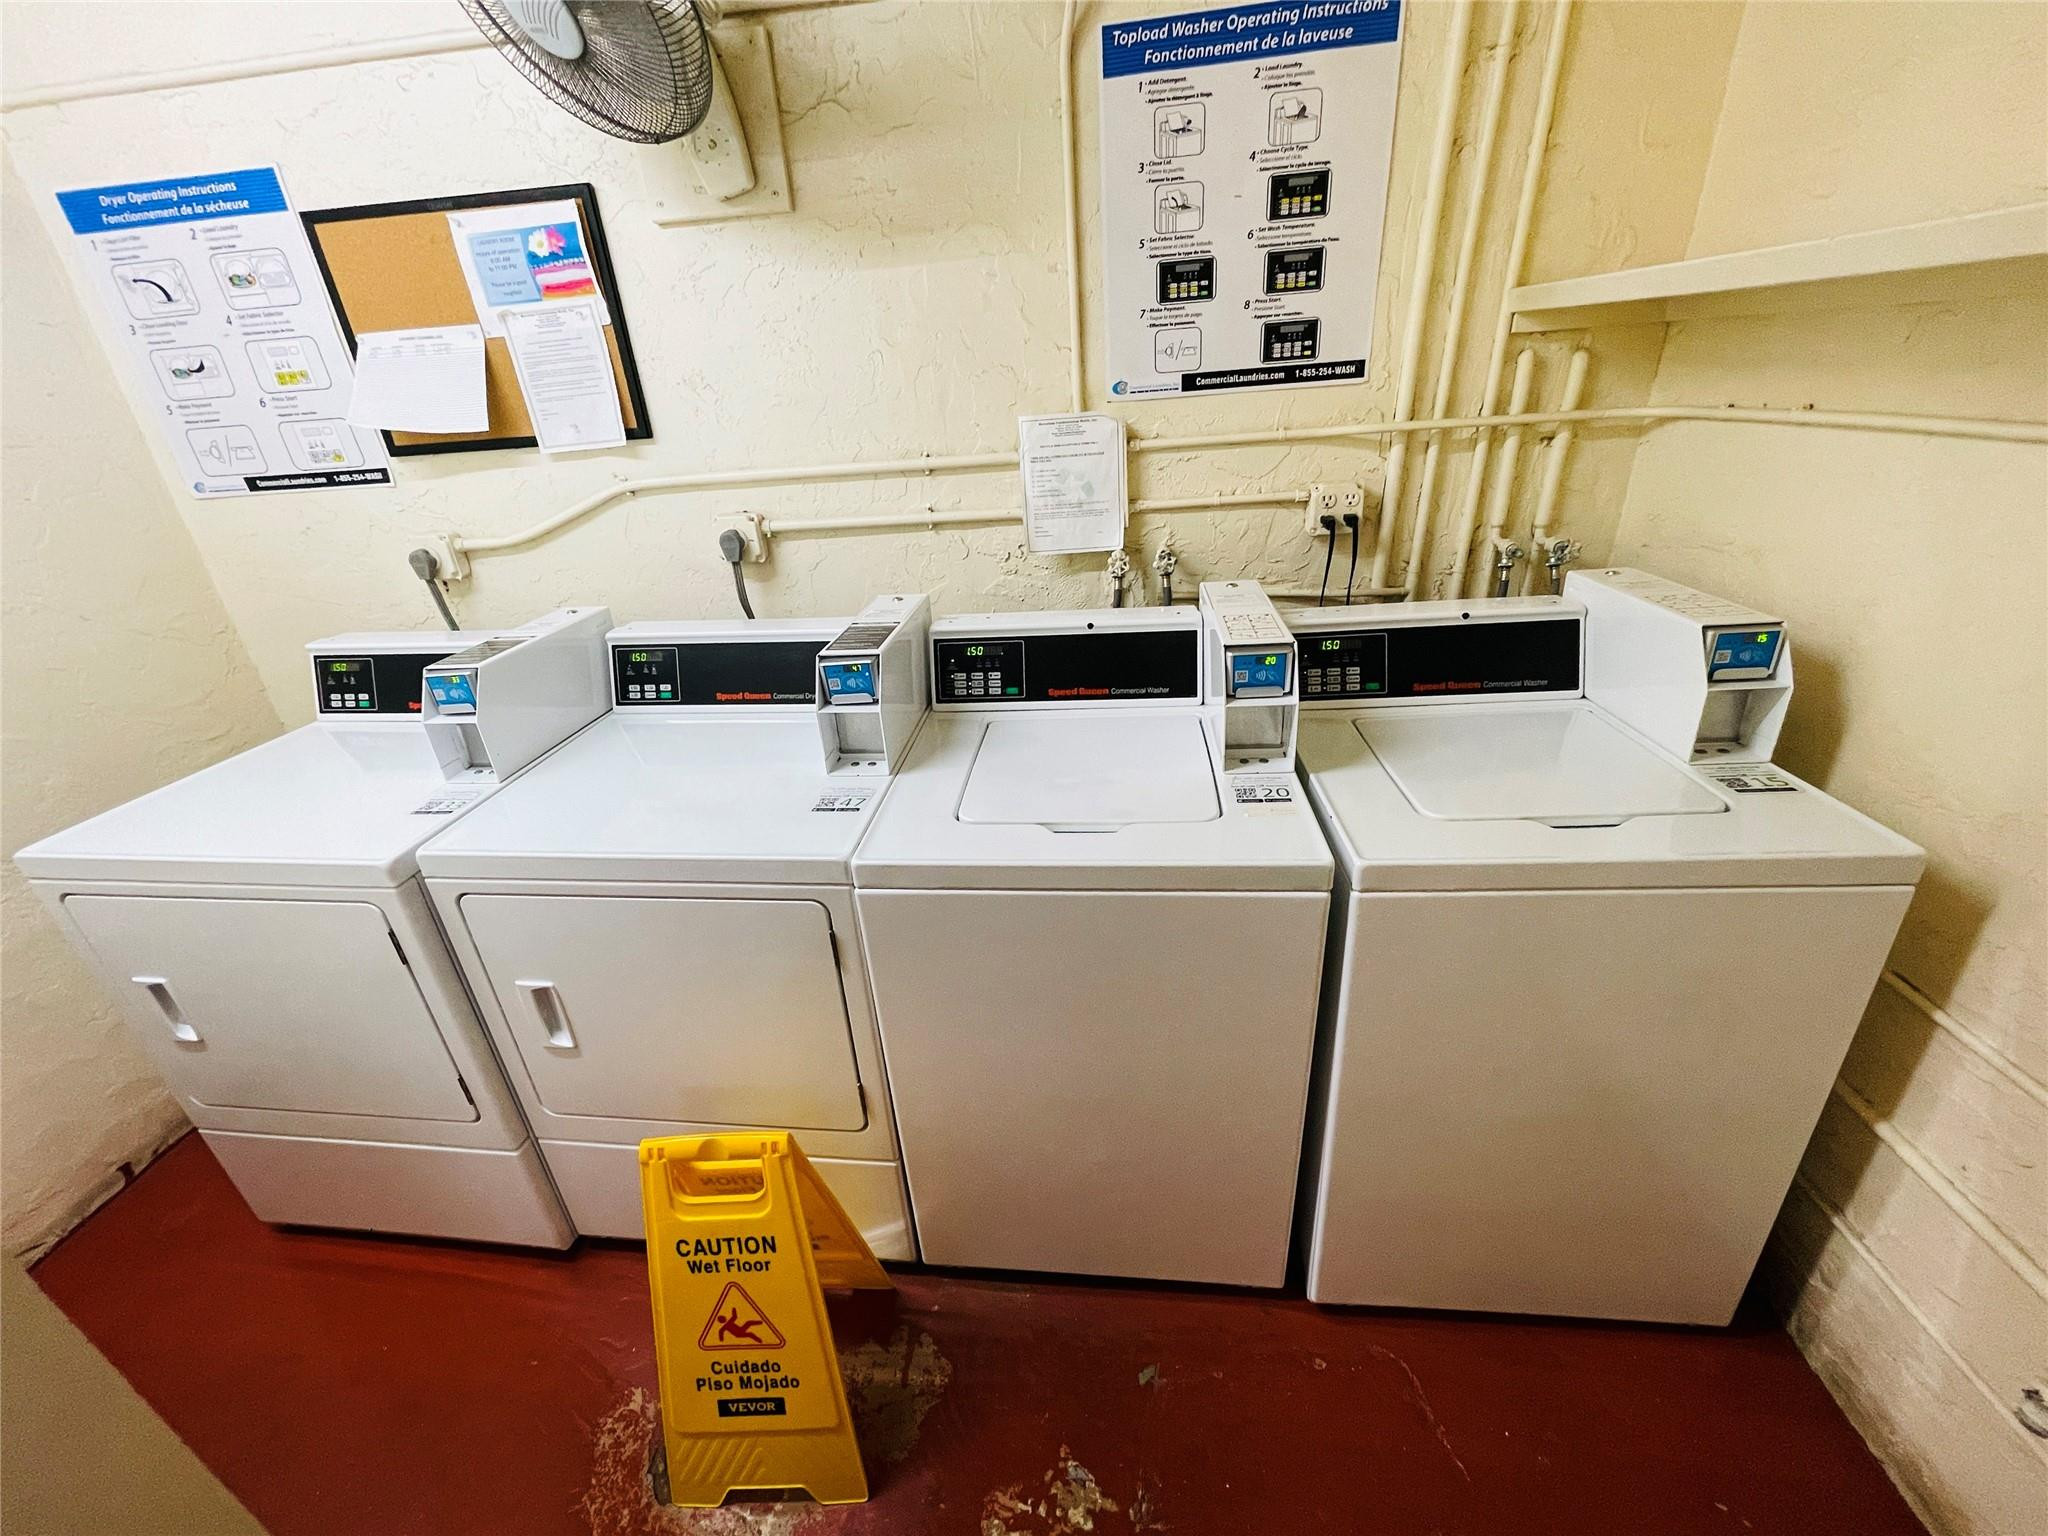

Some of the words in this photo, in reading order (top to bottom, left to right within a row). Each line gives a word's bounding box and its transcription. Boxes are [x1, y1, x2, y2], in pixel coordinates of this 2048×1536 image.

[1112, 24, 1168, 47] Topload
[1172, 15, 1223, 38] Washer
[1226, 7, 1299, 32] Operating
[1302, 0, 1389, 20] Instructions
[1144, 37, 1258, 65] Fonctionnement
[1261, 33, 1278, 50] de
[1281, 32, 1295, 47] la
[1298, 25, 1354, 45] laveuse
[1253, 67, 1261, 79] 2
[1138, 81, 1143, 93] 1
[1249, 150, 1256, 162] 4
[1138, 162, 1145, 174] 3
[98, 194, 127, 209] Dryer
[127, 188, 177, 205] Operating
[178, 180, 237, 197] Instructions
[102, 207, 179, 226] Fonctionnement
[180, 204, 192, 215] de
[193, 203, 204, 214] la
[205, 198, 250, 213] sécheuse
[190, 228, 197, 240] 2
[1247, 229, 1254, 240] 6
[1138, 238, 1145, 249] 5
[1244, 300, 1250, 310] 8
[225, 314, 233, 326] 4
[1140, 309, 1146, 319] 7
[129, 325, 136, 336] 3
[1196, 372, 1285, 386] CommercialLaundries.com
[1295, 364, 1356, 378] 1-855-254-WASH
[259, 397, 266, 408] 6
[166, 405, 173, 416] 5
[1264, 656, 1277, 665] 20
[1483, 680, 1522, 688] Commercial
[1523, 679, 1549, 687] Washer
[716, 692, 743, 701] Speed
[743, 692, 772, 700] Queen
[773, 692, 804, 700] Commercial
[1048, 688, 1078, 697] Speed
[1078, 688, 1110, 696] Queen
[1111, 687, 1146, 695] Commercial
[1261, 788, 1290, 798] 20
[839, 797, 867, 807] 47
[676, 1236, 776, 1258] CAUTION
[687, 1259, 721, 1274] Wet
[726, 1258, 771, 1274] Floor
[711, 1360, 782, 1375] Cuidado
[696, 1376, 734, 1392] Piso
[738, 1375, 800, 1392] Mojado
[728, 1402, 776, 1413] VEVOR
